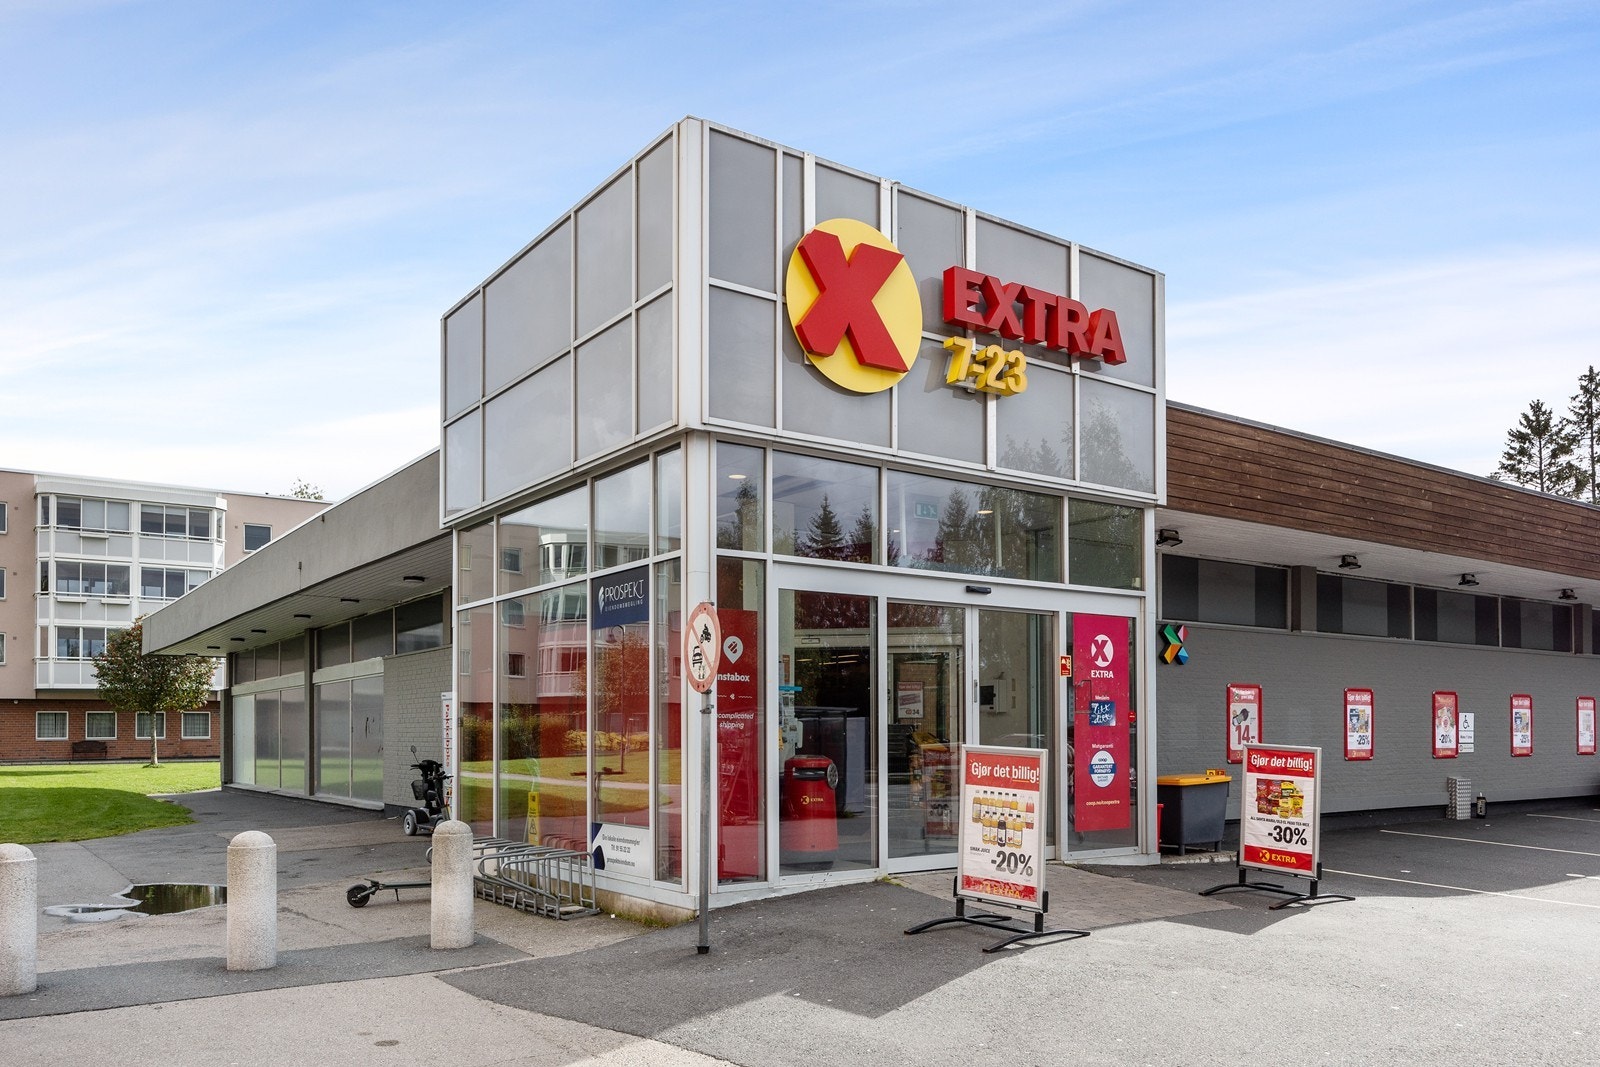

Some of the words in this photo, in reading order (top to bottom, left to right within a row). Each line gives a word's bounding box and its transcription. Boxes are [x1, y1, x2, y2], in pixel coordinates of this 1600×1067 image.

[943, 265, 1127, 366] EXTRA
[943, 335, 1028, 397] 7-23
[604, 580, 644, 602] PROSPEKT
[717, 672, 750, 682] nstabox
[1091, 670, 1114, 678] EXTRA
[718, 712, 754, 720] complicated
[719, 721, 745, 730] shipping
[1251, 754, 1269, 768] Gjør
[1270, 756, 1286, 767] det
[1287, 757, 1313, 772] billig!
[971, 762, 992, 779] Gjør
[993, 764, 1011, 778] det
[1012, 765, 1040, 784] billig!
[1267, 825, 1308, 846] -30%
[990, 850, 1034, 877] -20%
[1271, 853, 1297, 864] EXTRA
